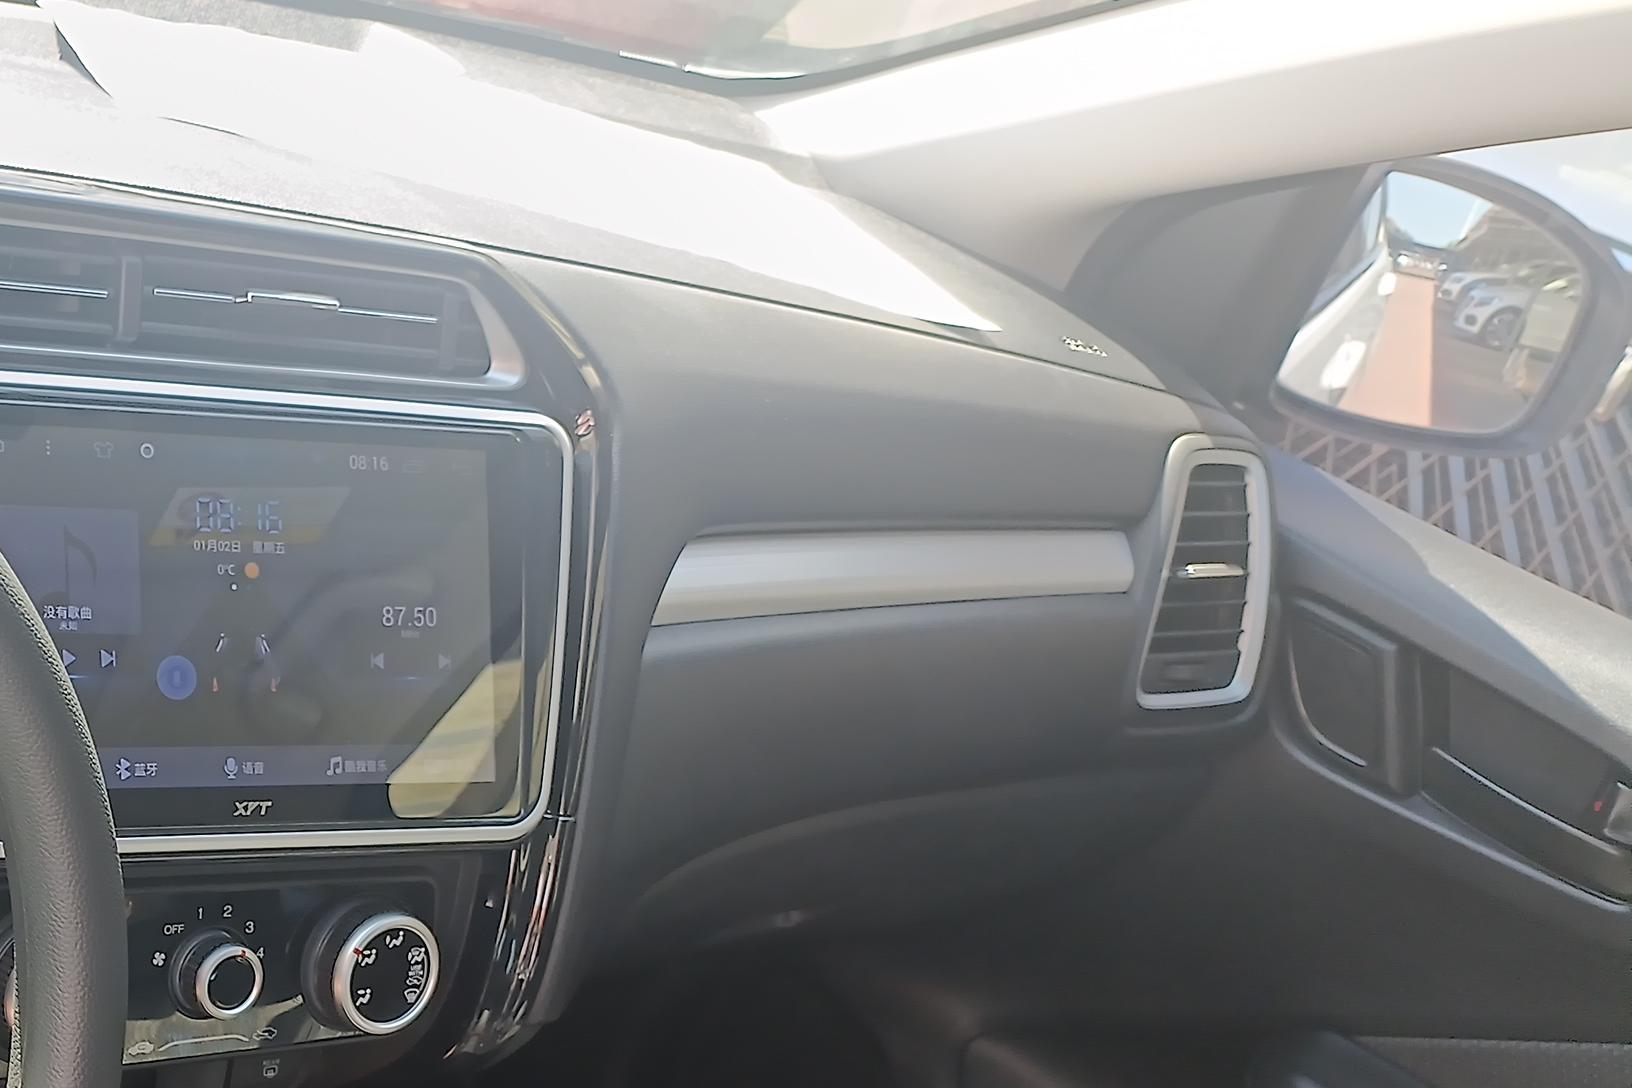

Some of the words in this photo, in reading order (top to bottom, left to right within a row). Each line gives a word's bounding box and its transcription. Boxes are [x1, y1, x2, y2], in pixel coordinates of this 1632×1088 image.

[349, 454, 389, 471] 08:16
[196, 497, 283, 534] 08:16
[43, 605, 92, 620] 没有歌曲
[382, 606, 437, 627] 87.50
[196, 908, 204, 919] 1
[223, 905, 233, 918] 2
[164, 924, 185, 935] OFF
[244, 921, 255, 934] 3
[256, 947, 265, 959] 4
